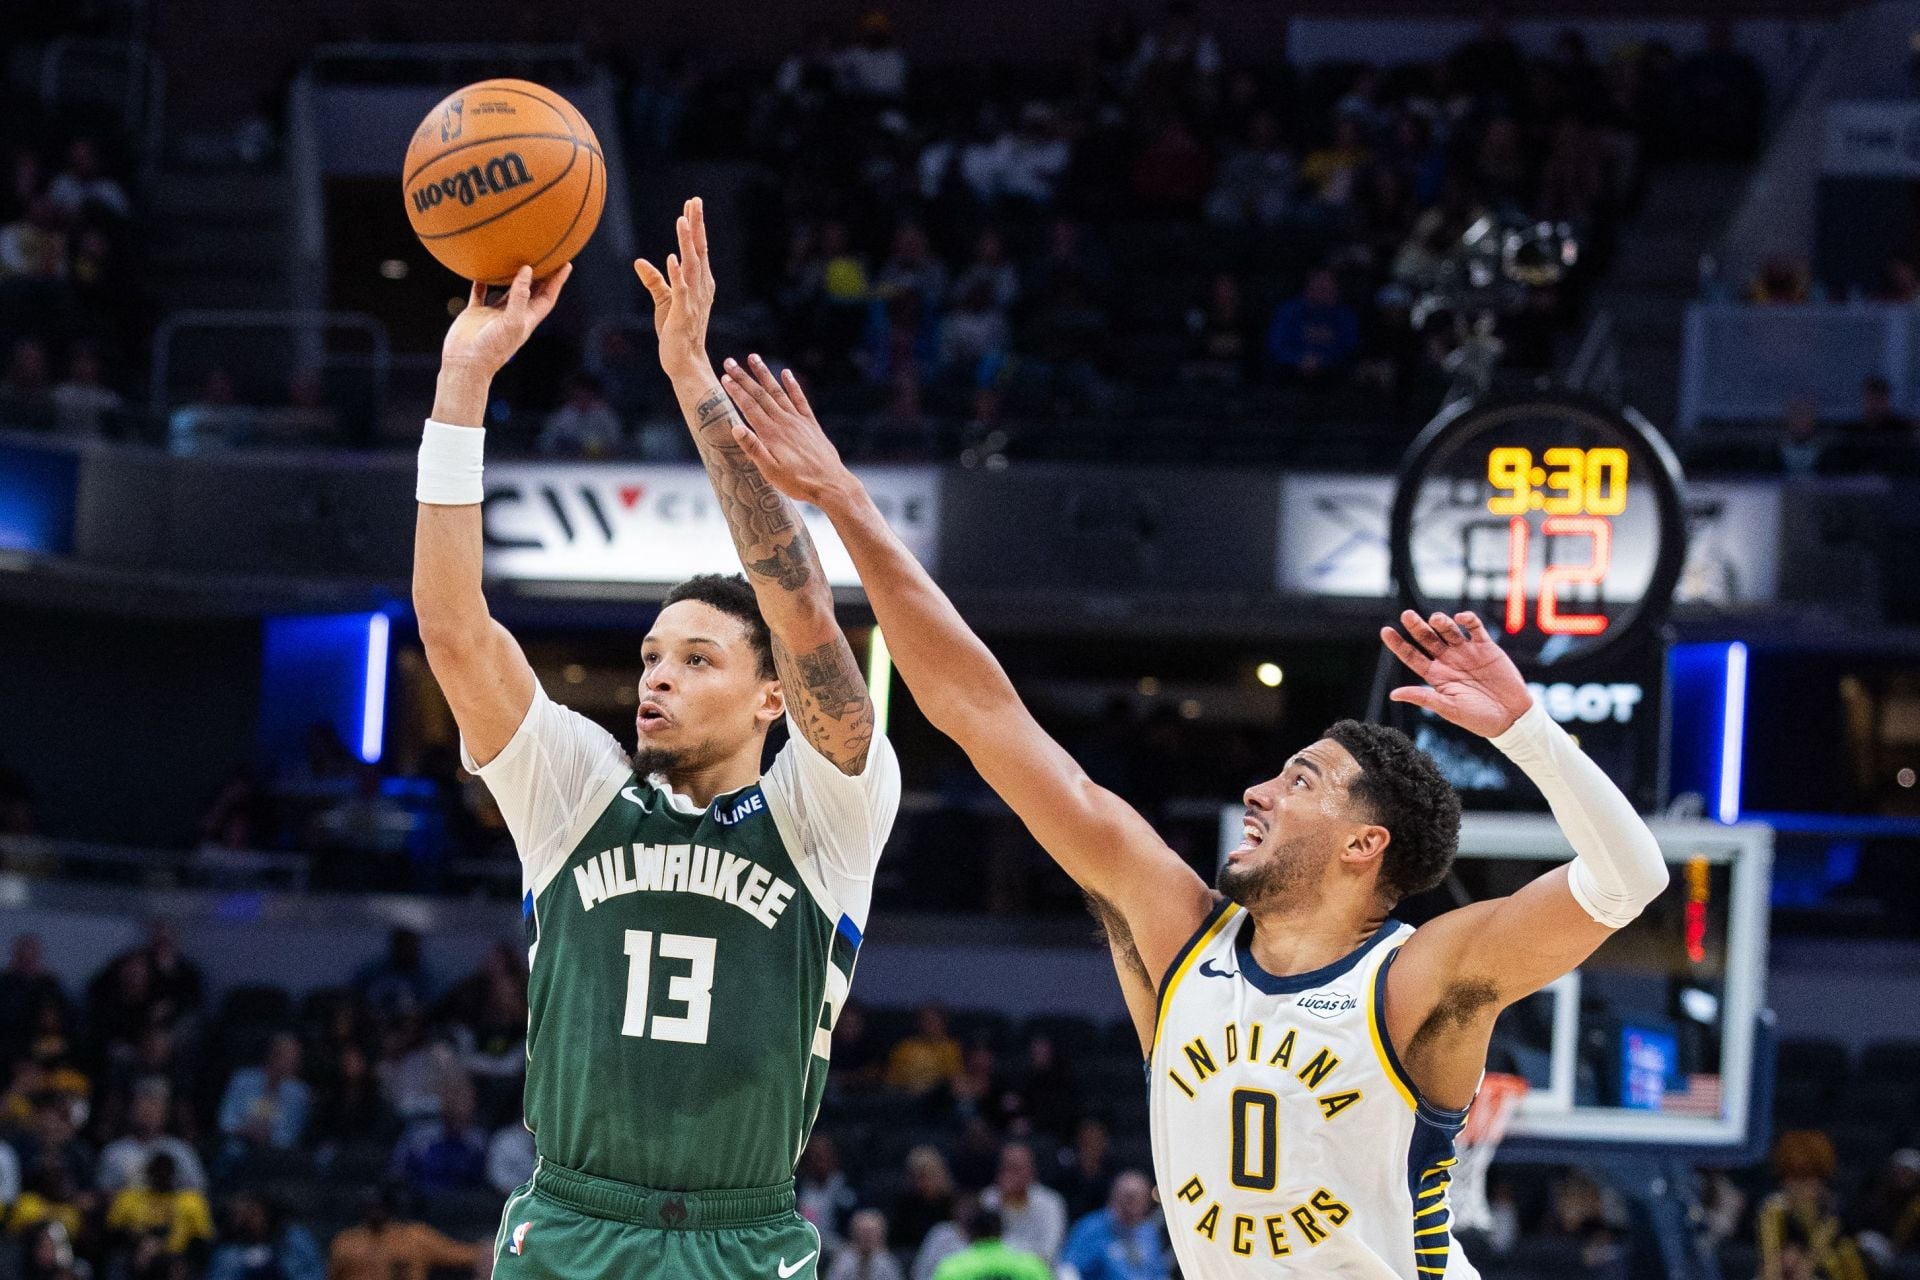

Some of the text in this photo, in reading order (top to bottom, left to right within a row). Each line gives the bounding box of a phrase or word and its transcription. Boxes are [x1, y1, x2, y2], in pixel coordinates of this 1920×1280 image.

[412, 152, 534, 214] Wilson
[1488, 447, 1628, 515] 9:30
[1505, 515, 1613, 635] 12
[713, 794, 763, 825] ULINE
[573, 842, 797, 930] MILWAUKEE
[621, 929, 718, 1045] 13
[1296, 997, 1358, 1010] LUCAS OIL
[1169, 1020, 1364, 1121] INDIANA
[1229, 1086, 1279, 1193] 0
[1177, 1173, 1352, 1258] PACERS
